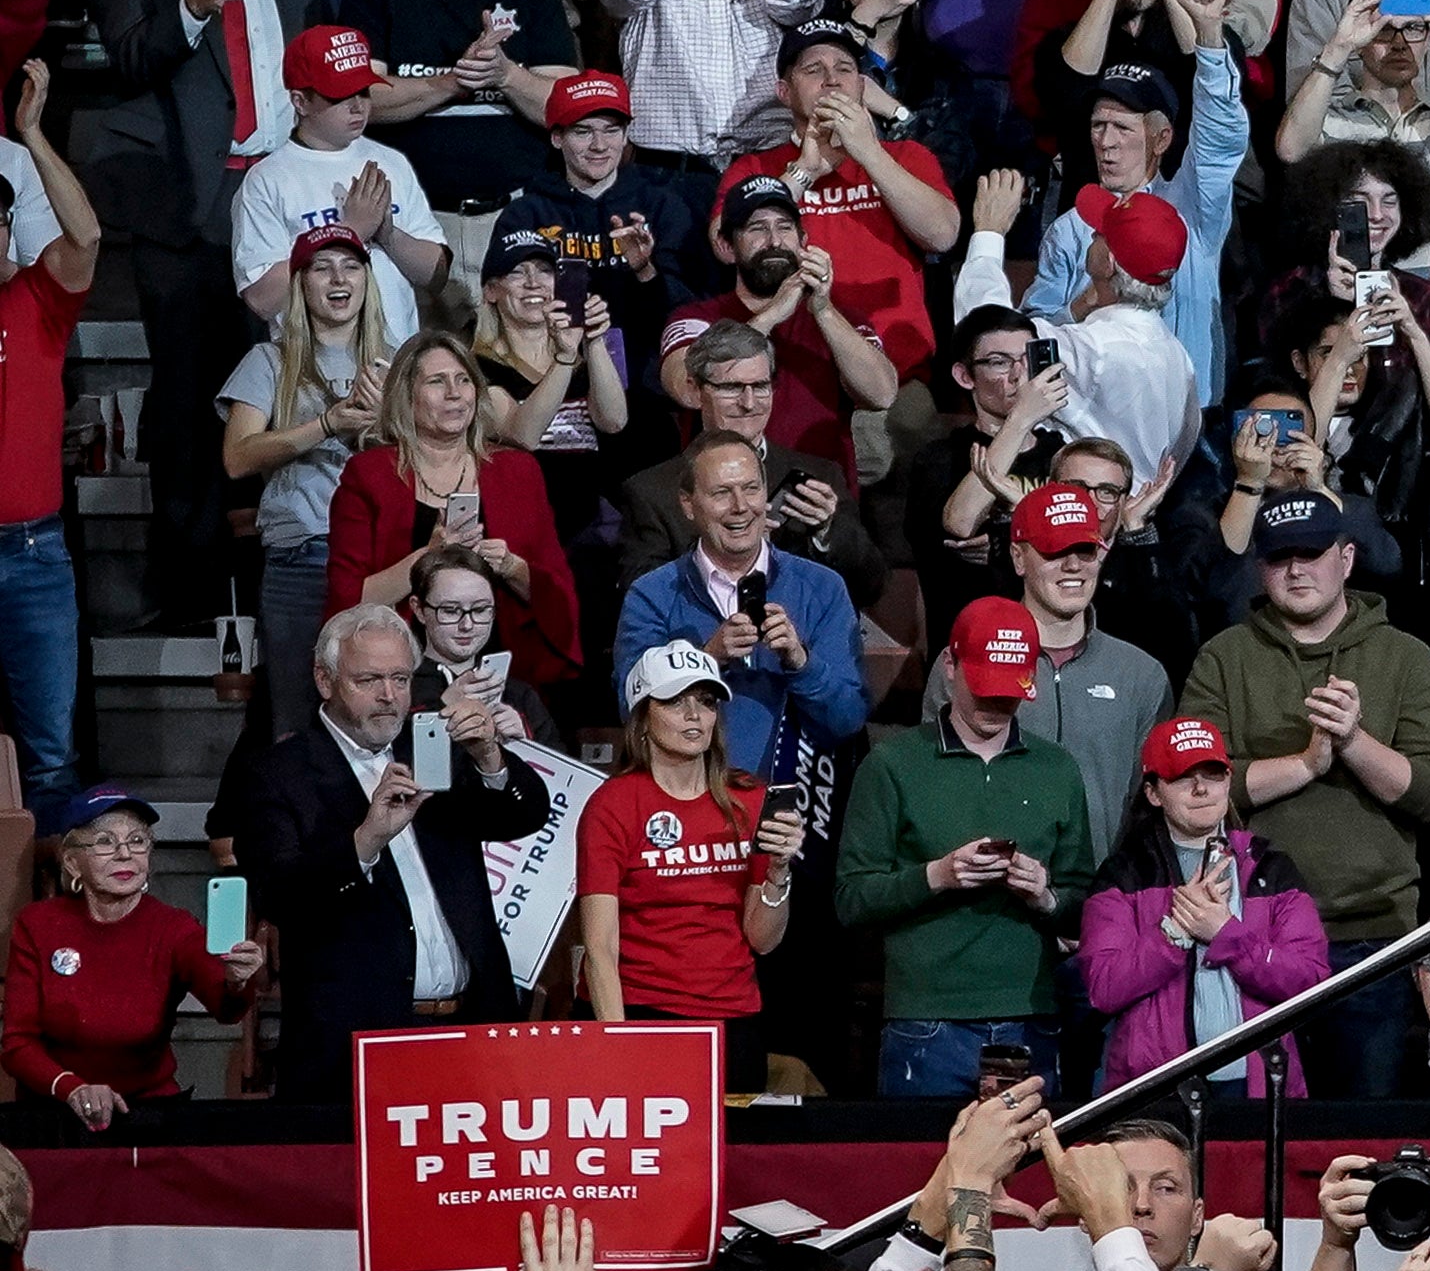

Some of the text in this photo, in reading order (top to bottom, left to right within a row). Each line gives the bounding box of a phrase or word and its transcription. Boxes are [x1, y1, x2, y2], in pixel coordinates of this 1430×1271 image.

[741, 176, 785, 193] TRUMP
[501, 229, 545, 244] TRUMP
[1262, 500, 1317, 519] TRUMP
[666, 649, 714, 672] USA
[500, 791, 571, 937] FOR TRUMP
[656, 863, 720, 878] KEEP AMERICA
[387, 1098, 691, 1148] TRUMP
[416, 1148, 661, 1183] PENCE
[438, 1183, 639, 1205] KEEP AMERICA GREAT!
